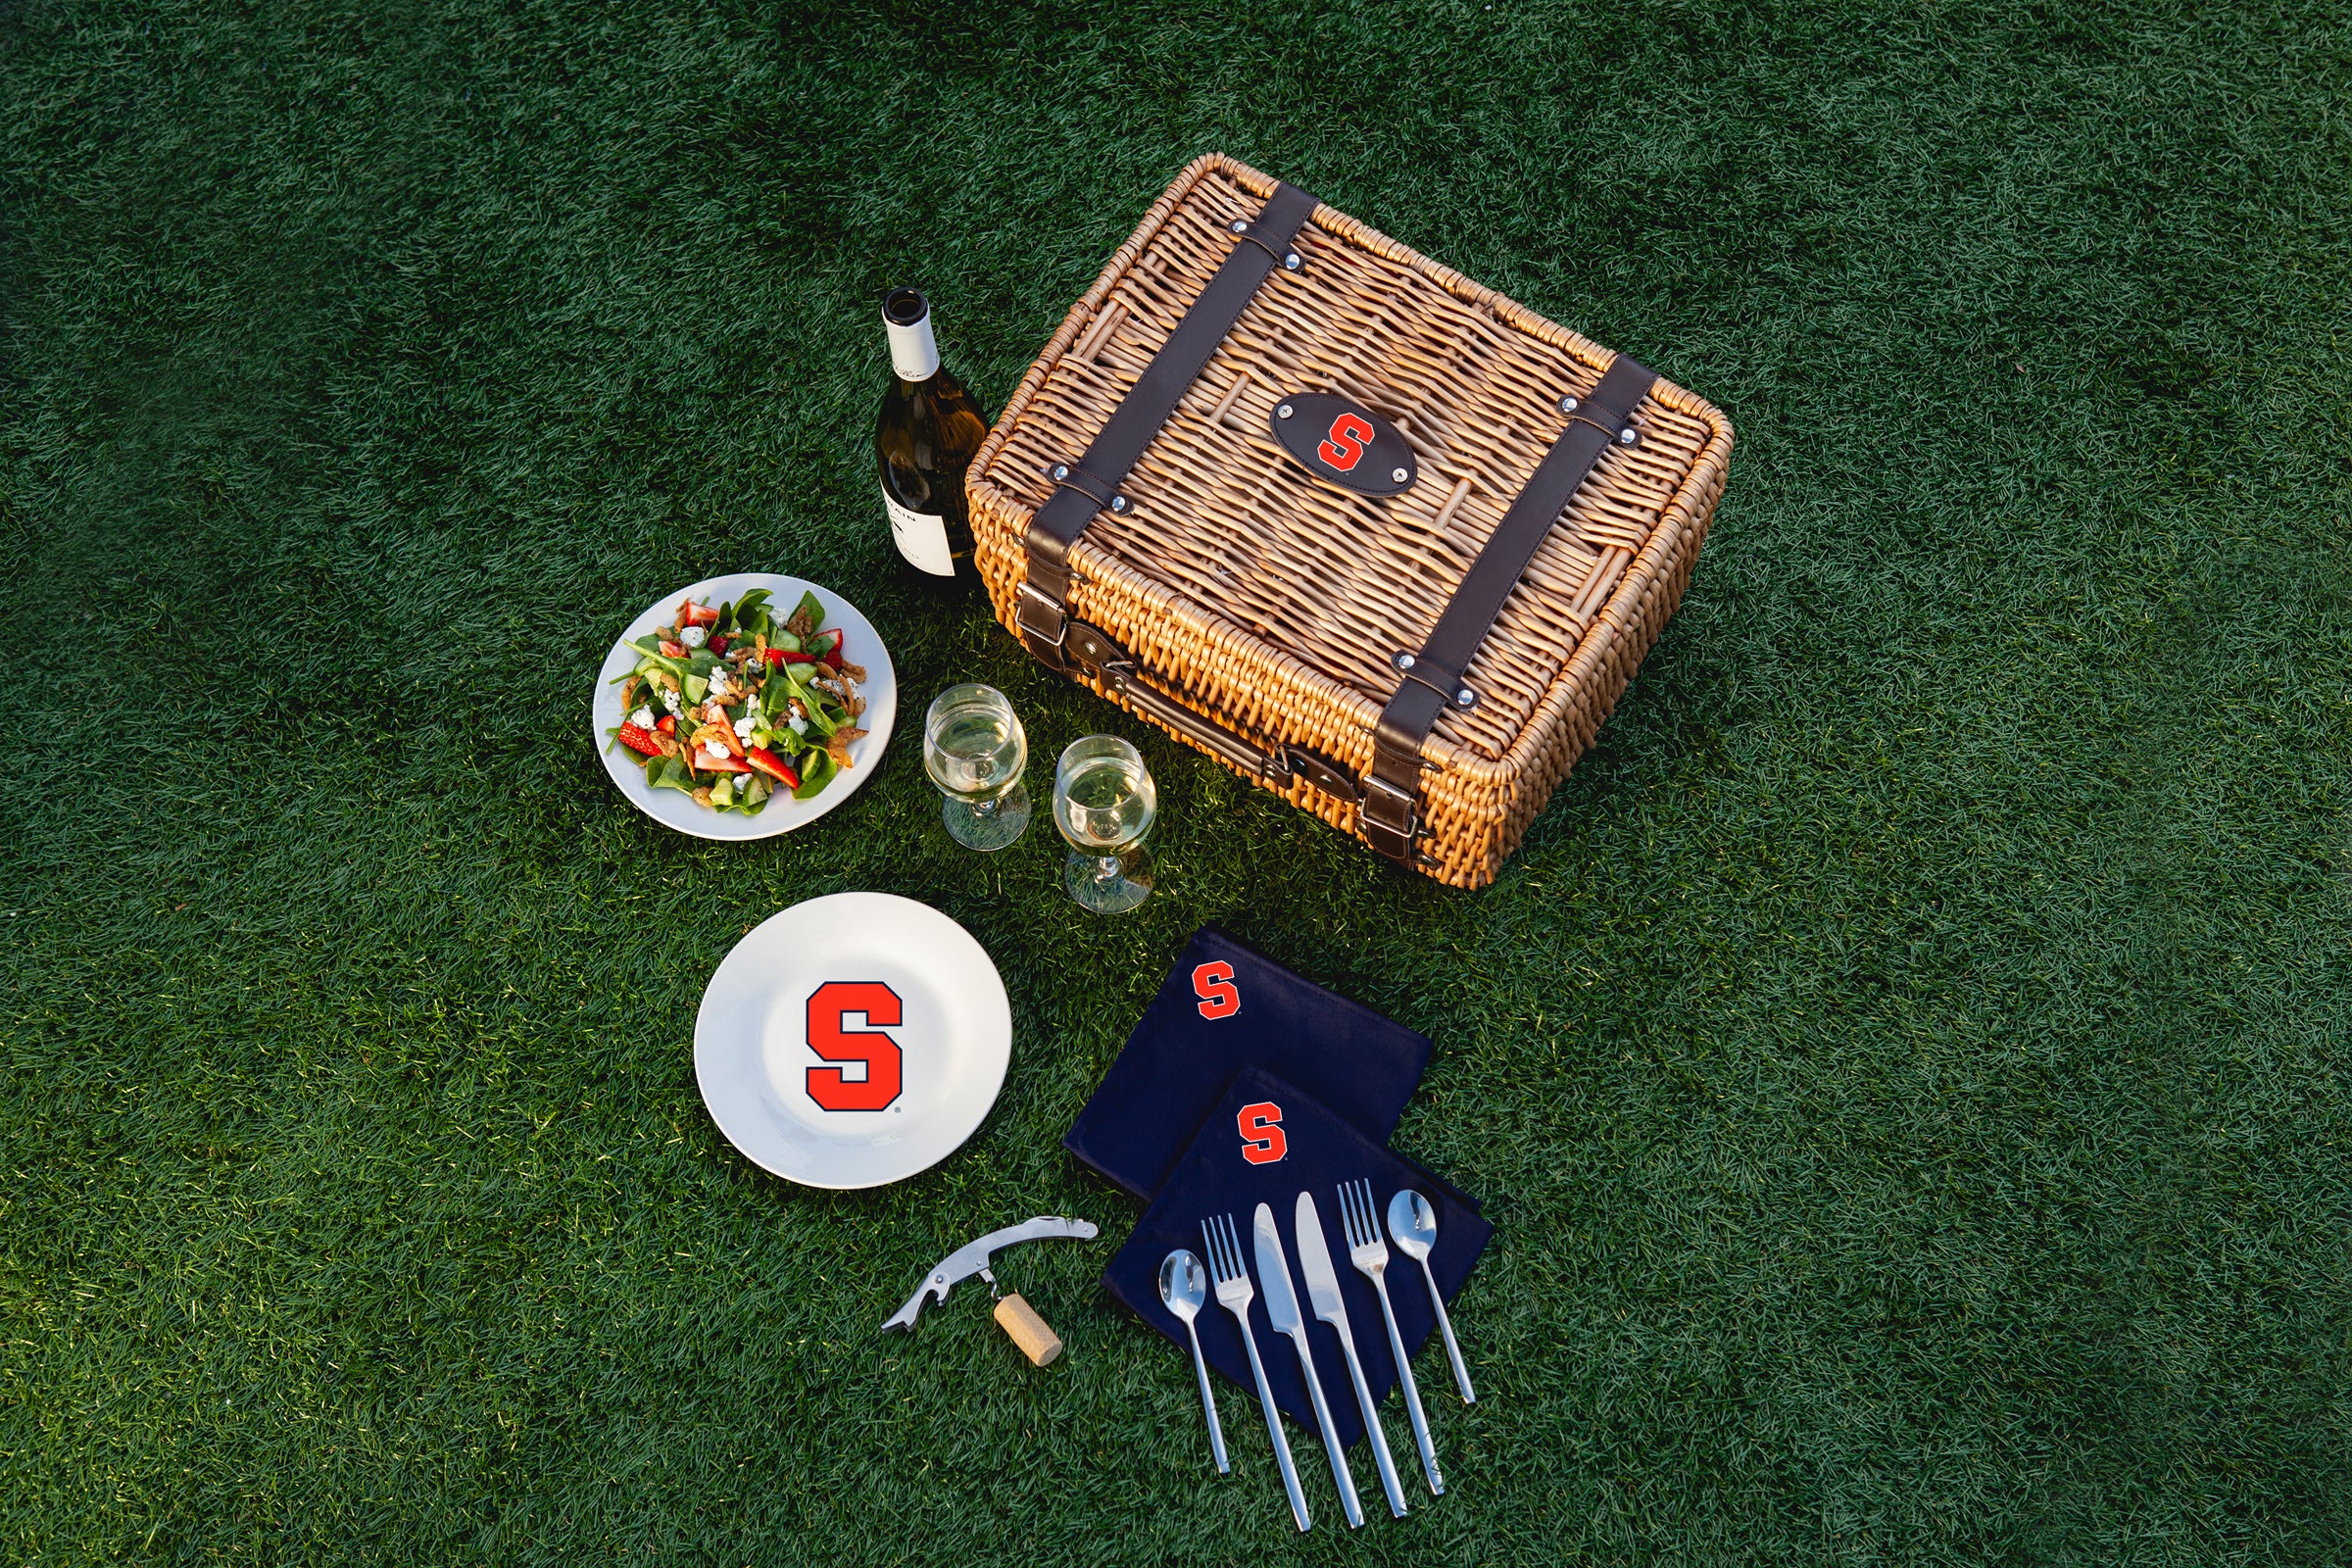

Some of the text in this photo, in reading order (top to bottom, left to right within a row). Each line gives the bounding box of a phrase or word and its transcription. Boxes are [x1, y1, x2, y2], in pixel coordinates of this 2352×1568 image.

[1317, 413, 1375, 471] S
[1192, 960, 1241, 1020] S
[806, 981, 903, 1112] S
[1237, 1102, 1288, 1165] S
